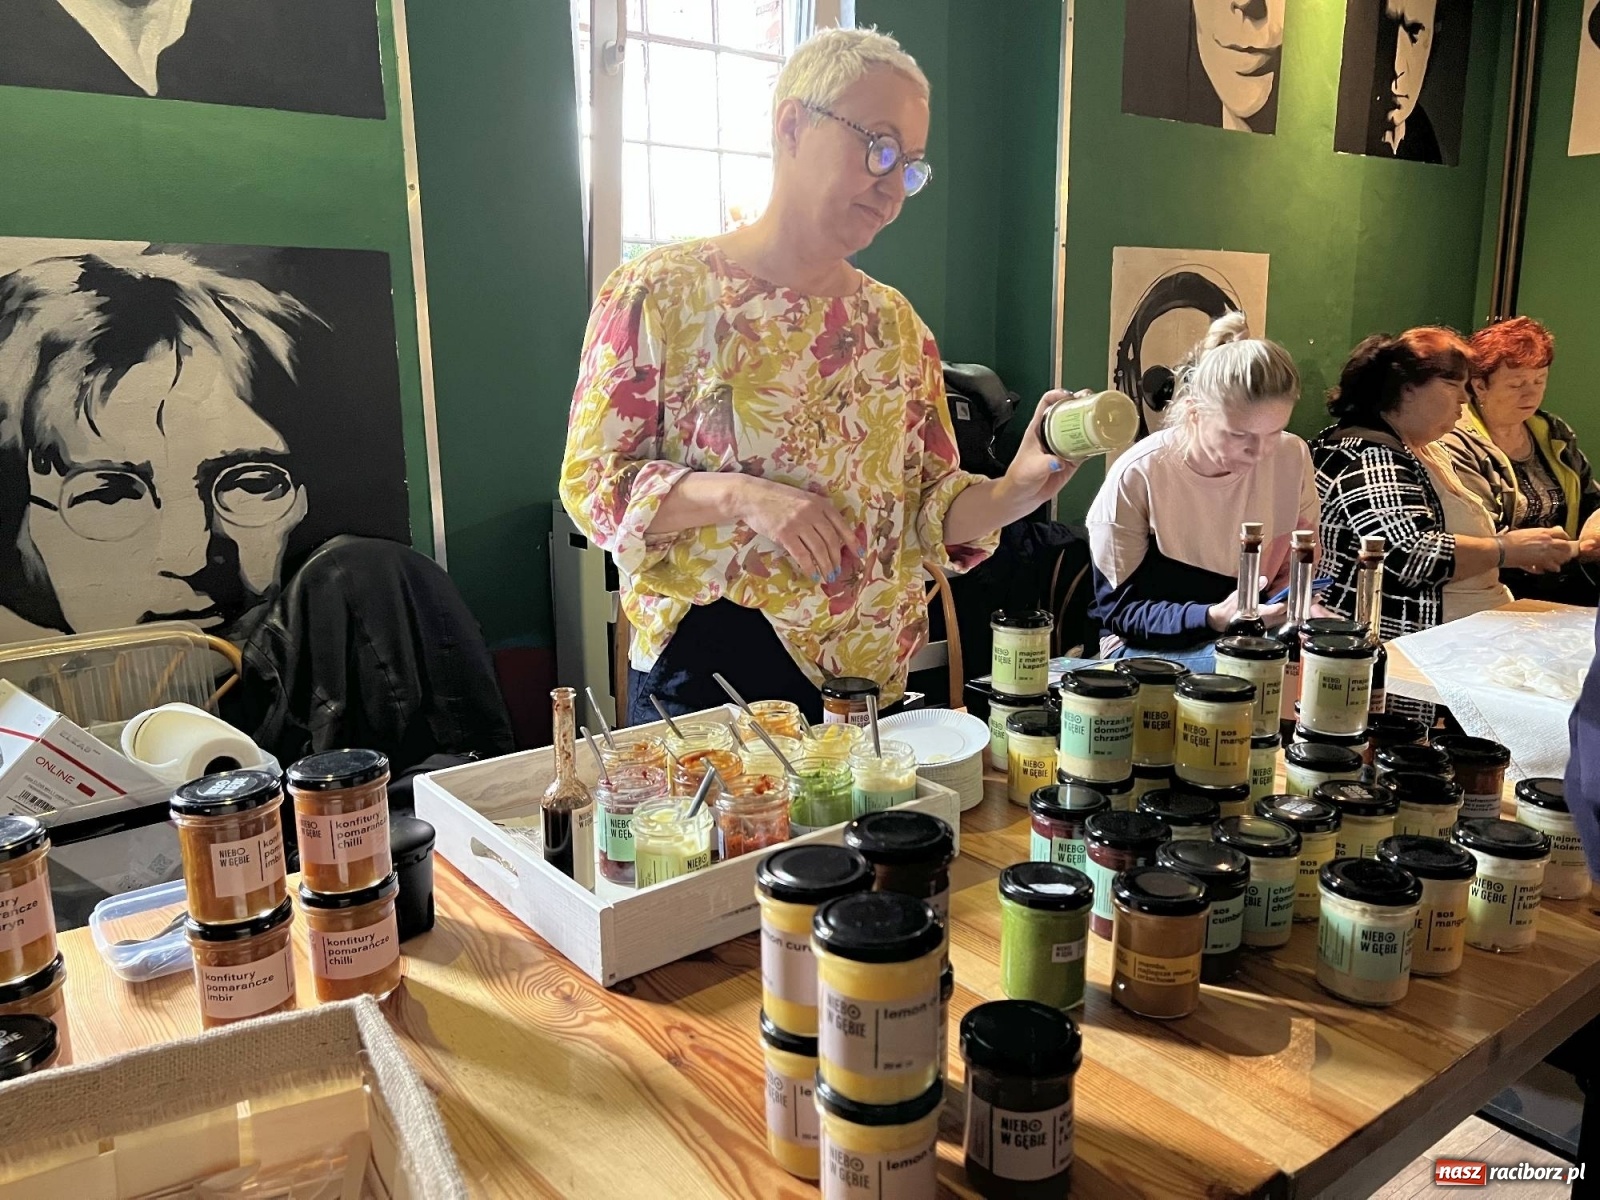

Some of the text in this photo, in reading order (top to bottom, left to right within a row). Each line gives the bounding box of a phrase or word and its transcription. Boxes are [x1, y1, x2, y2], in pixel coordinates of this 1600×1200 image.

[994, 648, 1010, 658] NIEBO
[998, 656, 1012, 665] GĘBIE
[850, 714, 869, 722] NIEBO
[1064, 710, 1082, 724] NIEBO
[1143, 710, 1168, 720] NIEBO
[1068, 722, 1085, 736] GĘBIE
[1143, 720, 1172, 732] W GĘBIE
[1183, 722, 1208, 736] NIEBO
[1183, 732, 1211, 748] W GĘBIE
[35, 756, 76, 784] ONLINE
[1022, 758, 1046, 768] NIEBO
[1022, 768, 1048, 779] W GĘBIE
[1252, 767, 1272, 776] NIEBO
[1252, 776, 1258, 785] W
[336, 810, 380, 829] konfitury
[306, 830, 322, 840] GĘBIE
[610, 828, 618, 838] W
[338, 836, 363, 850] chilli
[1058, 842, 1085, 854] NIEBO
[219, 847, 246, 858] NIEBO
[1058, 853, 1066, 862] W
[220, 854, 250, 868] W GĘBIE
[687, 853, 708, 870] NIEBO
[1470, 888, 1508, 905] W GĘBIE
[1213, 907, 1230, 916] sos
[326, 932, 376, 947] konfitury
[1362, 930, 1396, 943] NIEBO
[328, 936, 390, 957] pomarańcze
[1360, 942, 1399, 957] W GĘBIE
[329, 956, 354, 966] chilli
[205, 970, 256, 982] konfitury
[206, 974, 274, 992] pomarańcze
[208, 994, 234, 1002] imbir
[827, 992, 861, 1020] NIEBO
[884, 1003, 927, 1020] lemon
[836, 1017, 867, 1039] GĘBIE
[1001, 1117, 1043, 1134] NIEBO
[1001, 1132, 1048, 1150] W GĘBIE
[830, 1147, 864, 1172] NIEBO
[886, 1152, 927, 1171] lemon
[839, 1168, 871, 1190] GĘBIE
